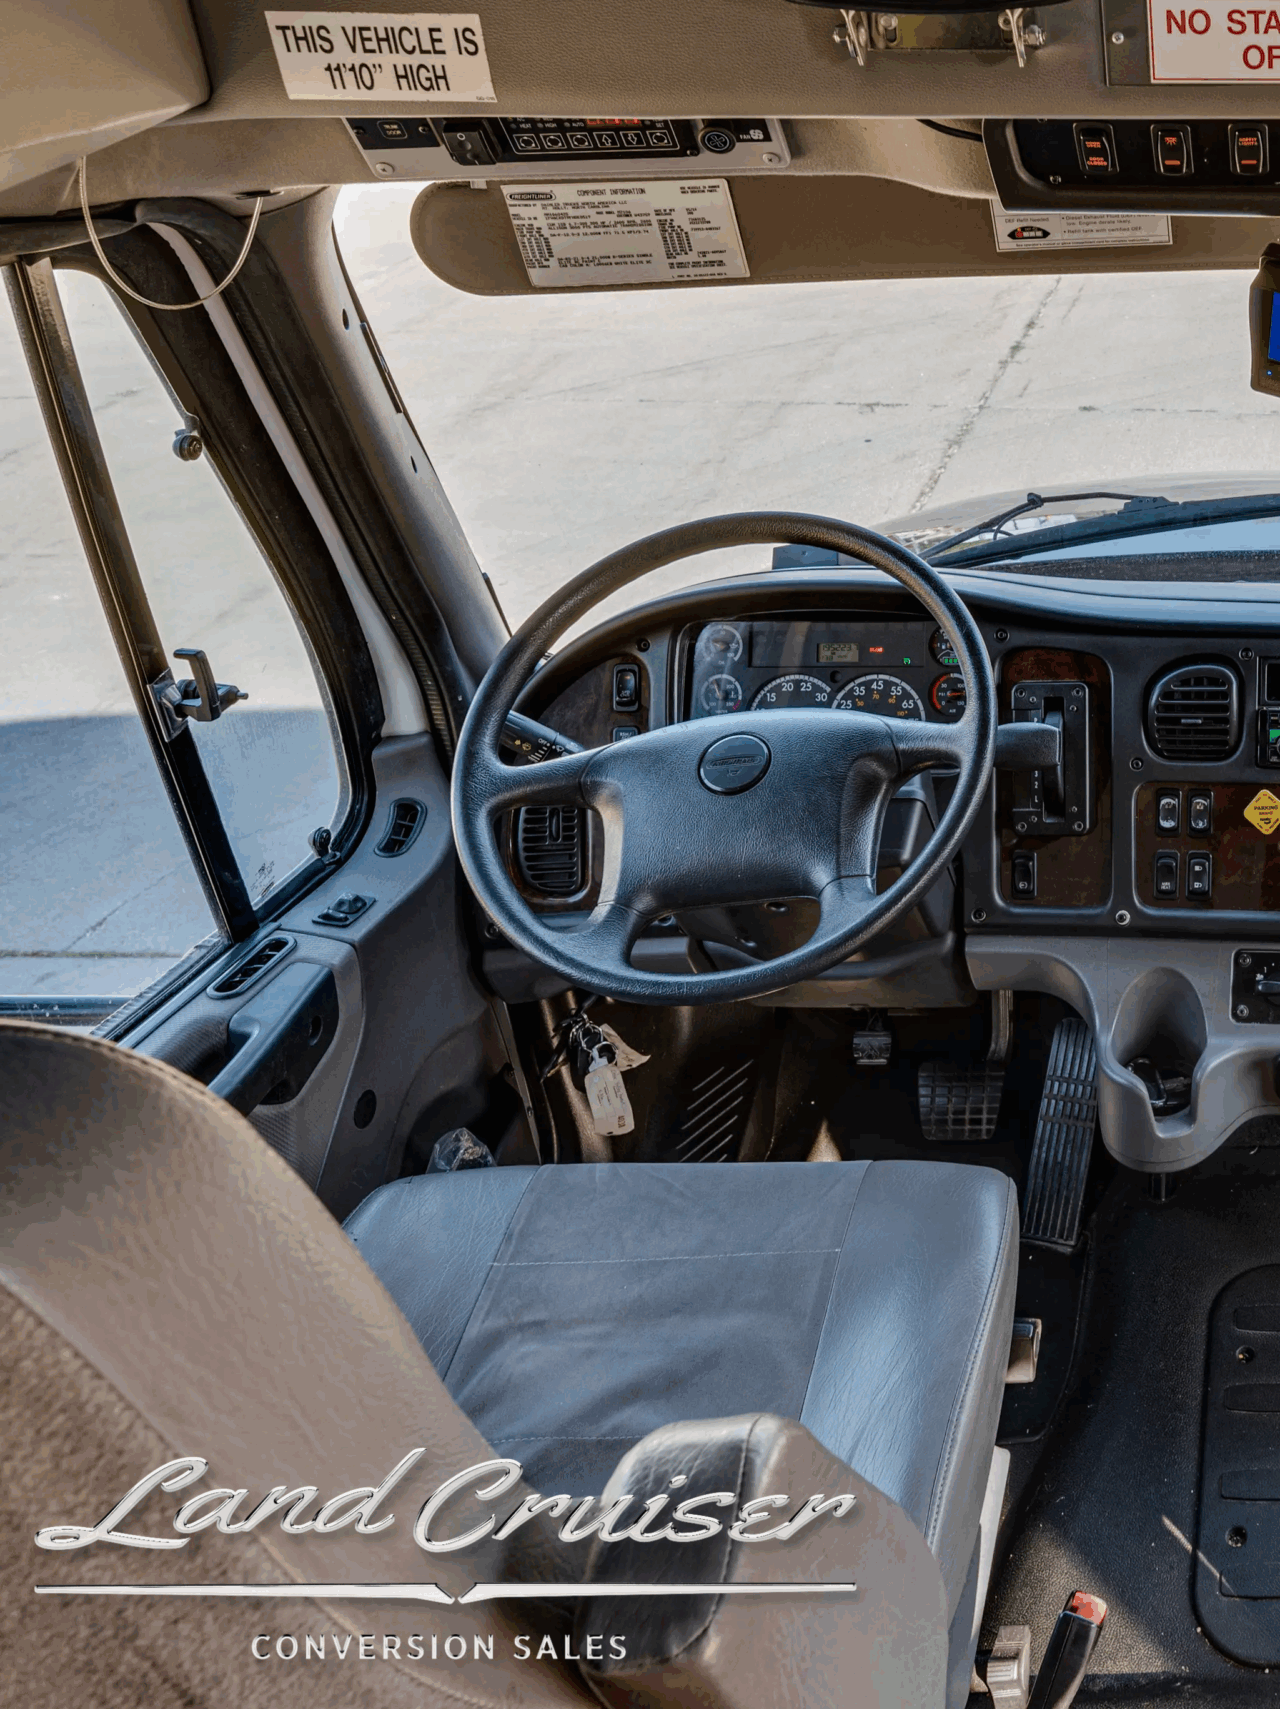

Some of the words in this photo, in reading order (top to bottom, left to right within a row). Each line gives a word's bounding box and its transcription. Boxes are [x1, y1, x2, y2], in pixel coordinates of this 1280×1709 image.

[1166, 9, 1211, 35] NO
[275, 25, 334, 54] THIS
[341, 26, 446, 55] VEHICLE
[454, 27, 479, 56] IS
[393, 64, 451, 91] HIGH
[782, 683, 794, 691] 20
[800, 683, 812, 691] 25
[871, 681, 884, 690] 45
[853, 686, 866, 696] 35
[890, 686, 902, 695] 55
[767, 693, 776, 702] 15
[815, 693, 828, 702] 30
[840, 700, 852, 708] 25
[902, 700, 914, 709] 65
